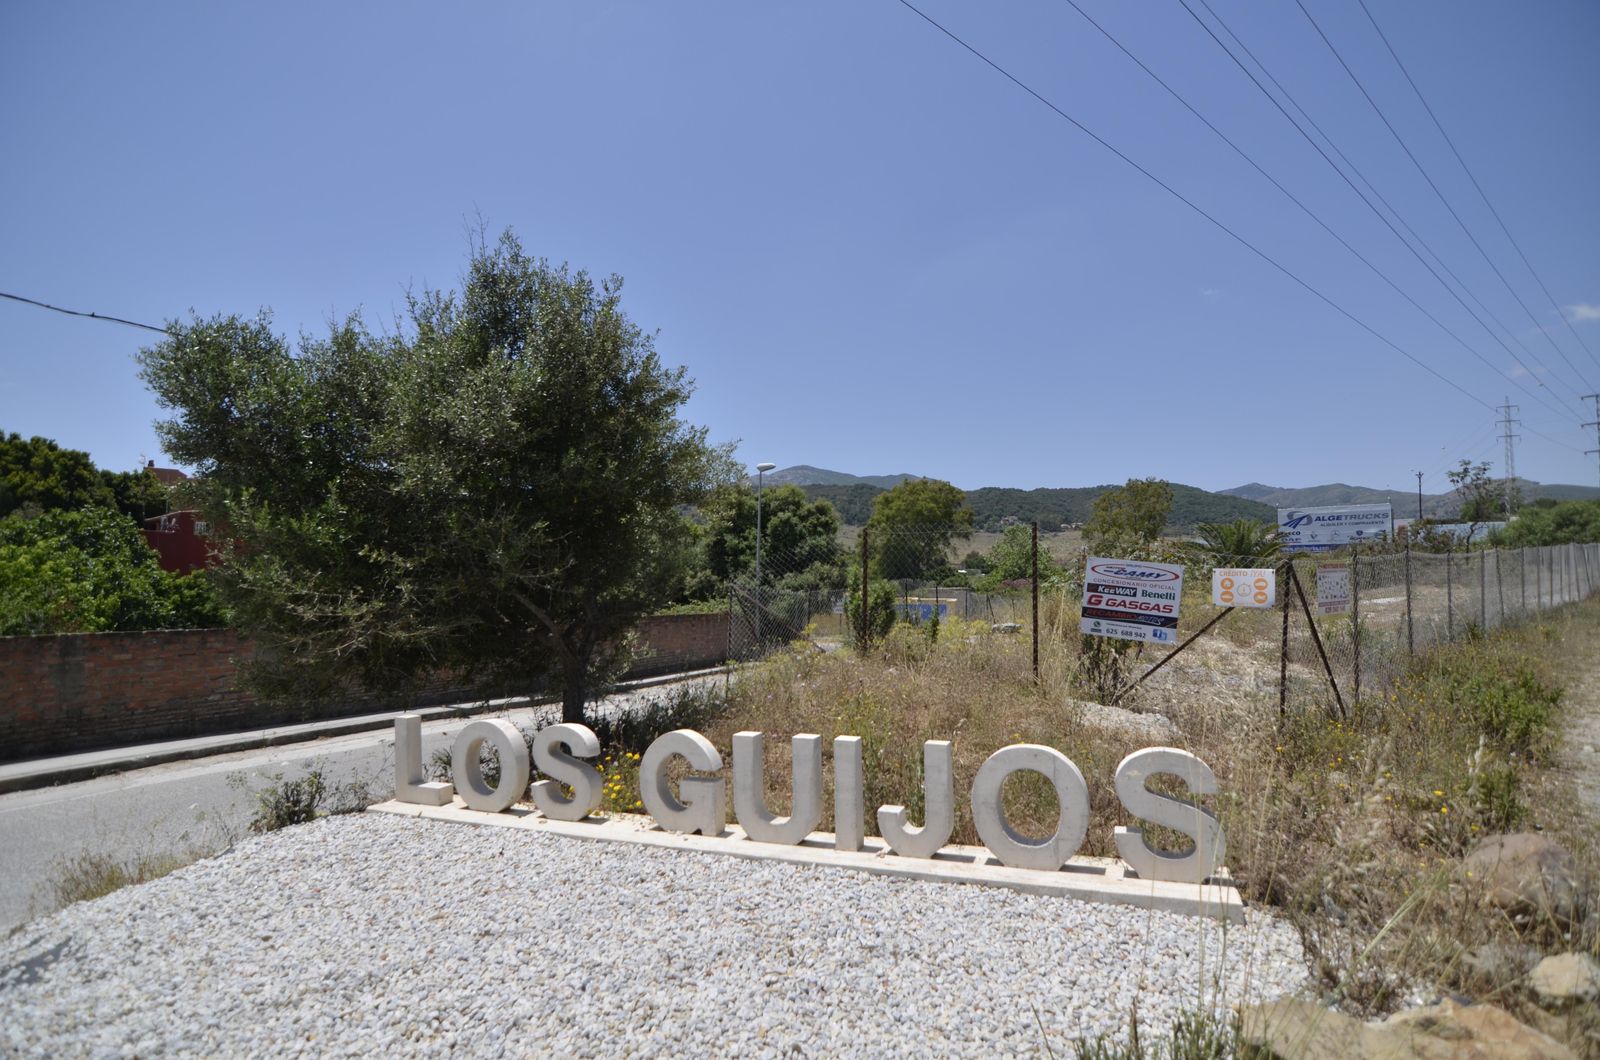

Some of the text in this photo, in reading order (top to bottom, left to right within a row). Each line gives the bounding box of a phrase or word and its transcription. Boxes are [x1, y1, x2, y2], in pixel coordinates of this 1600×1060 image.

[1314, 512, 1389, 522] ALGETRUCKS
[1092, 577, 1148, 588] CONCESIONARIO
[1141, 589, 1176, 601] Benelli
[1105, 598, 1174, 614] GASGAS
[394, 714, 1228, 883] LOS GUIJOS
